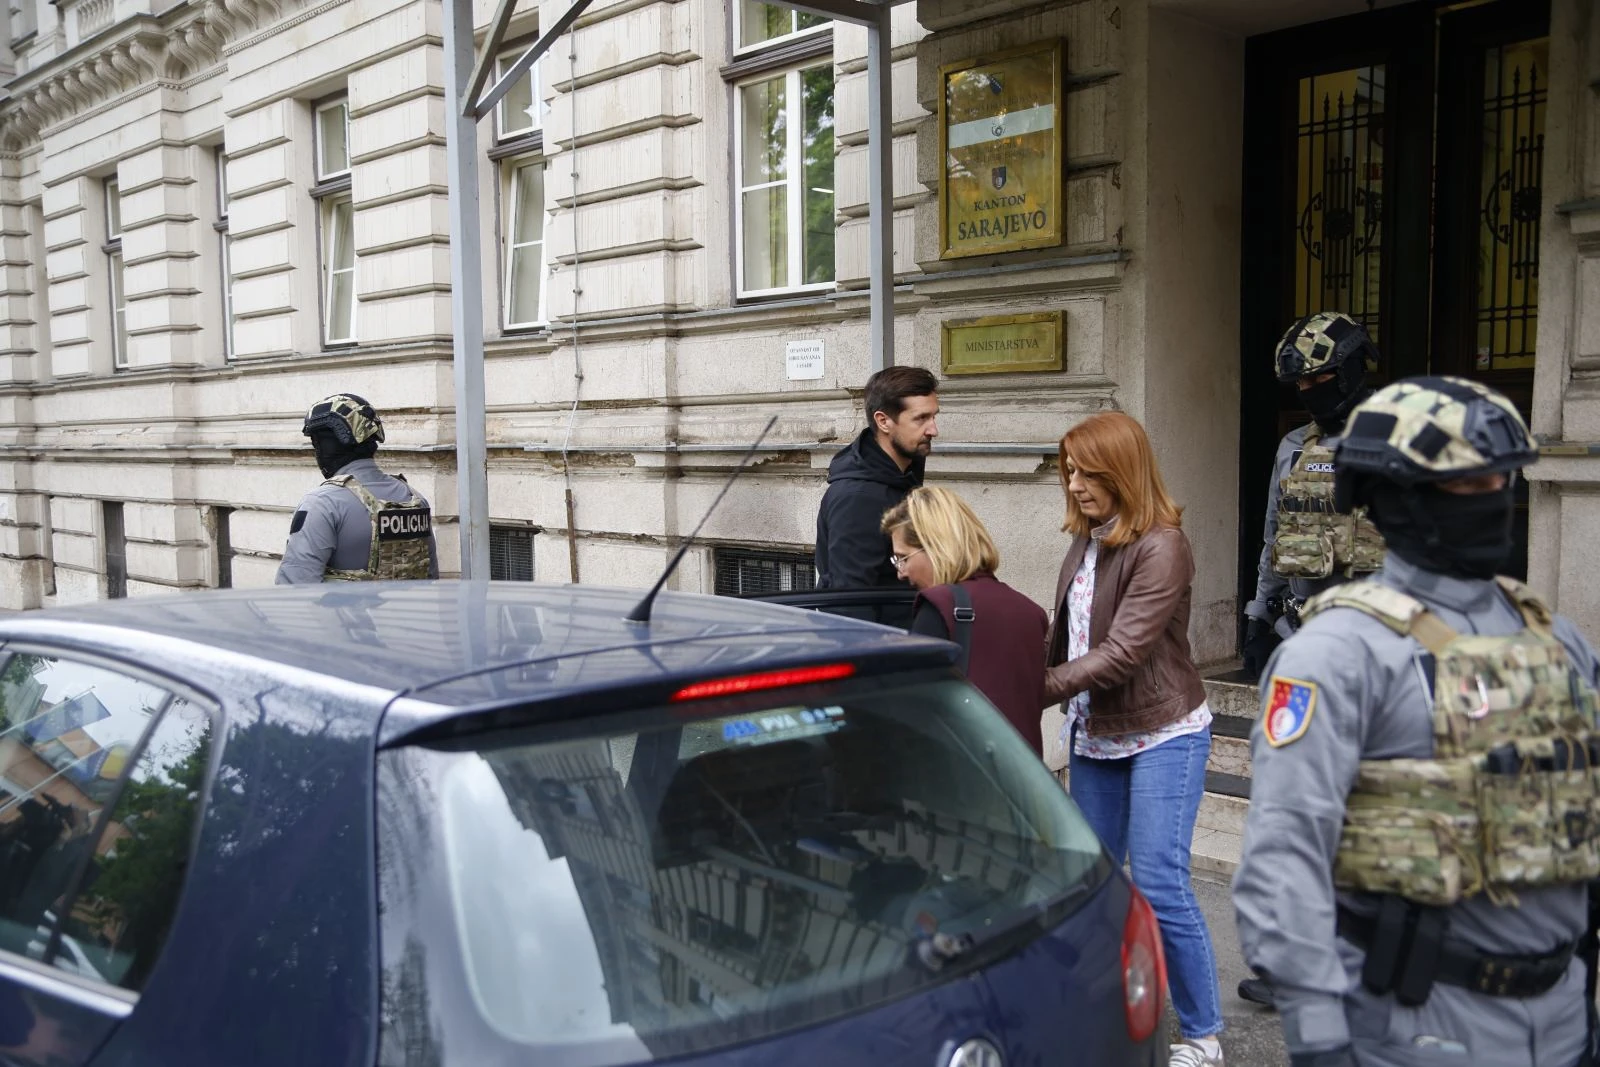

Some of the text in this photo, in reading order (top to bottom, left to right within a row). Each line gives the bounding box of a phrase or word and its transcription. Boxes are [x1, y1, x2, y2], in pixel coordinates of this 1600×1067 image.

[973, 193, 1027, 212] KANTON
[958, 210, 1047, 240] SARAJEVO
[965, 338, 1039, 353] MINISTARSTVA
[1307, 463, 1335, 473] POLICI
